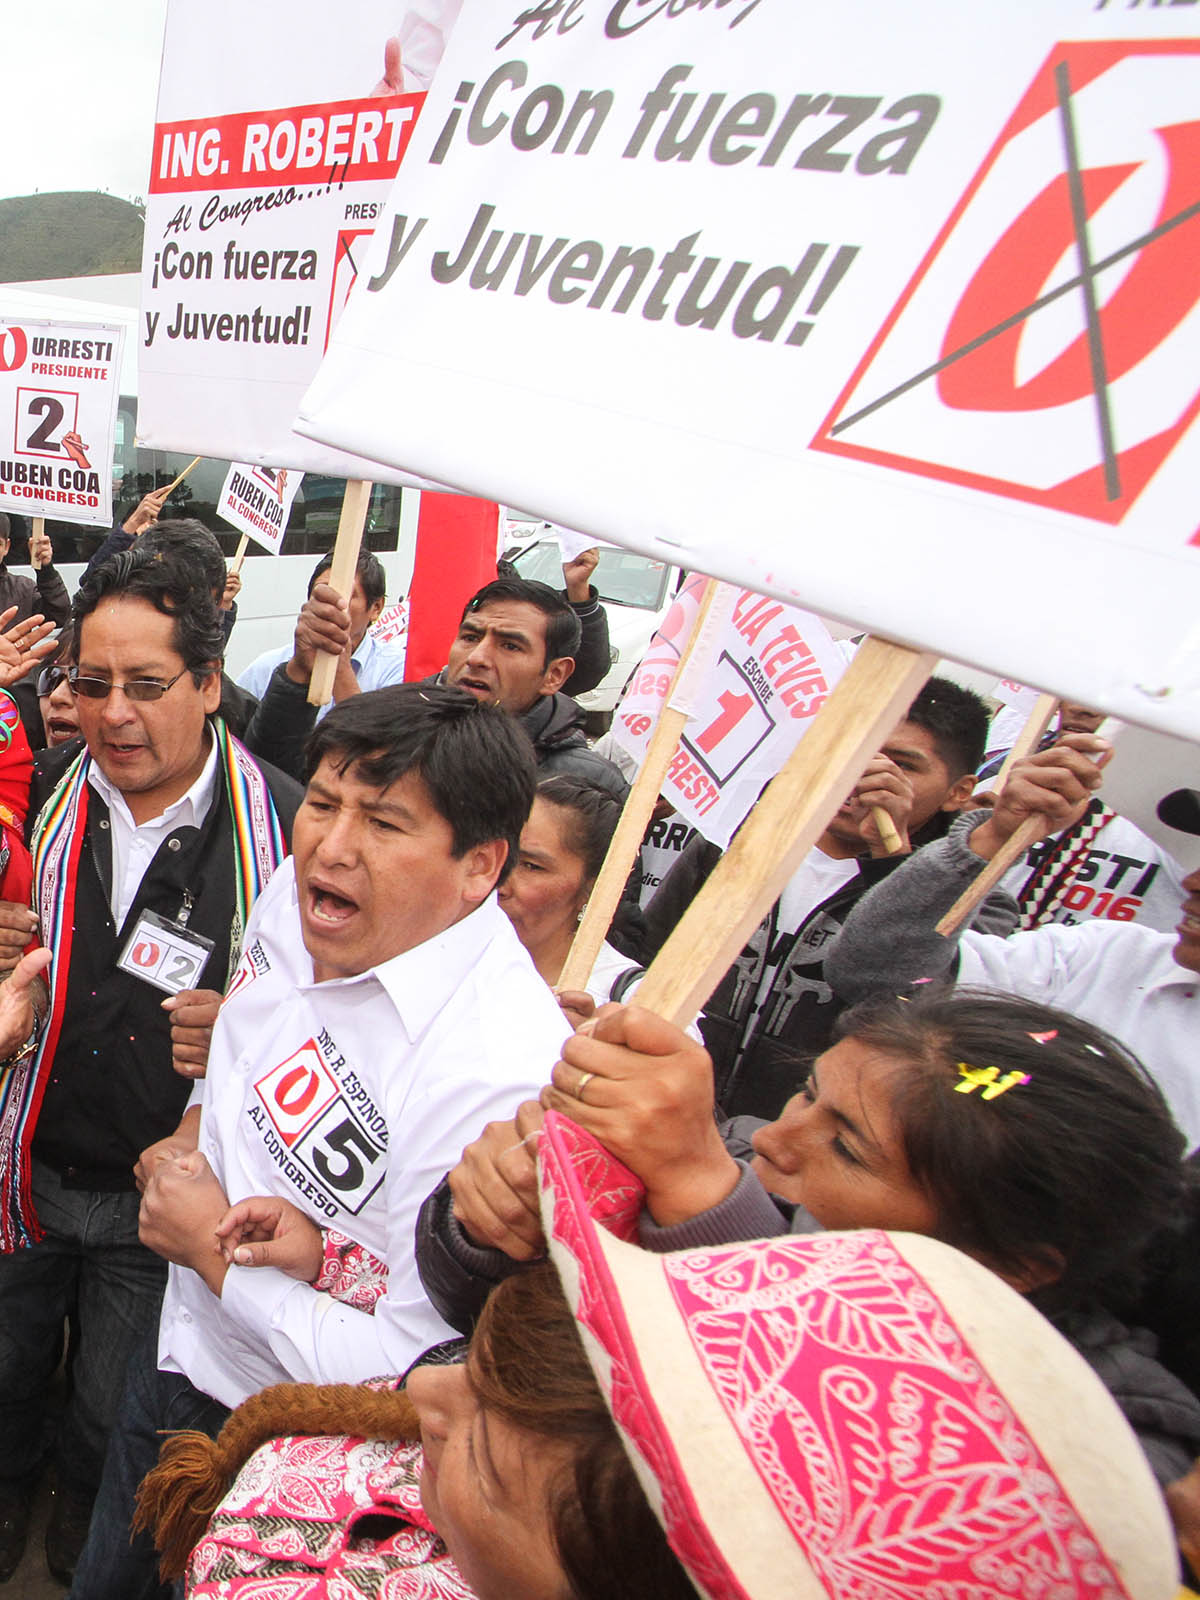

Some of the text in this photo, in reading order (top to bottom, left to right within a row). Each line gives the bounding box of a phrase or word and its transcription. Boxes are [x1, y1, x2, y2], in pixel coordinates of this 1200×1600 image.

[159, 106, 415, 180] ING. ROBERT
[429, 60, 944, 176] ¡Con fuerza
[163, 204, 192, 238] Al
[152, 240, 318, 288] ¡Con fuerza
[367, 203, 861, 347] y Juventud!
[31, 337, 113, 362] URRESTI
[145, 302, 311, 347] y Juventud!
[31, 362, 108, 380] PRESIDENTE
[26, 396, 64, 452] 2
[10, 484, 99, 508] CONGRESO
[58, 467, 101, 494] COA
[229, 471, 264, 512] RUBEN
[263, 501, 284, 528] COA
[227, 495, 279, 540] AL CONGRESO
[375, 604, 407, 629] JULIA
[731, 591, 830, 719] LIA TEVES
[742, 656, 774, 704] ESCRIBE
[695, 689, 754, 755] 1
[666, 744, 721, 817] RESTI
[1061, 885, 1144, 922] 016
[341, 1071, 390, 1147] ESPINOZ
[247, 1106, 339, 1218] AL CONGRESO
[312, 1117, 380, 1191] 5
